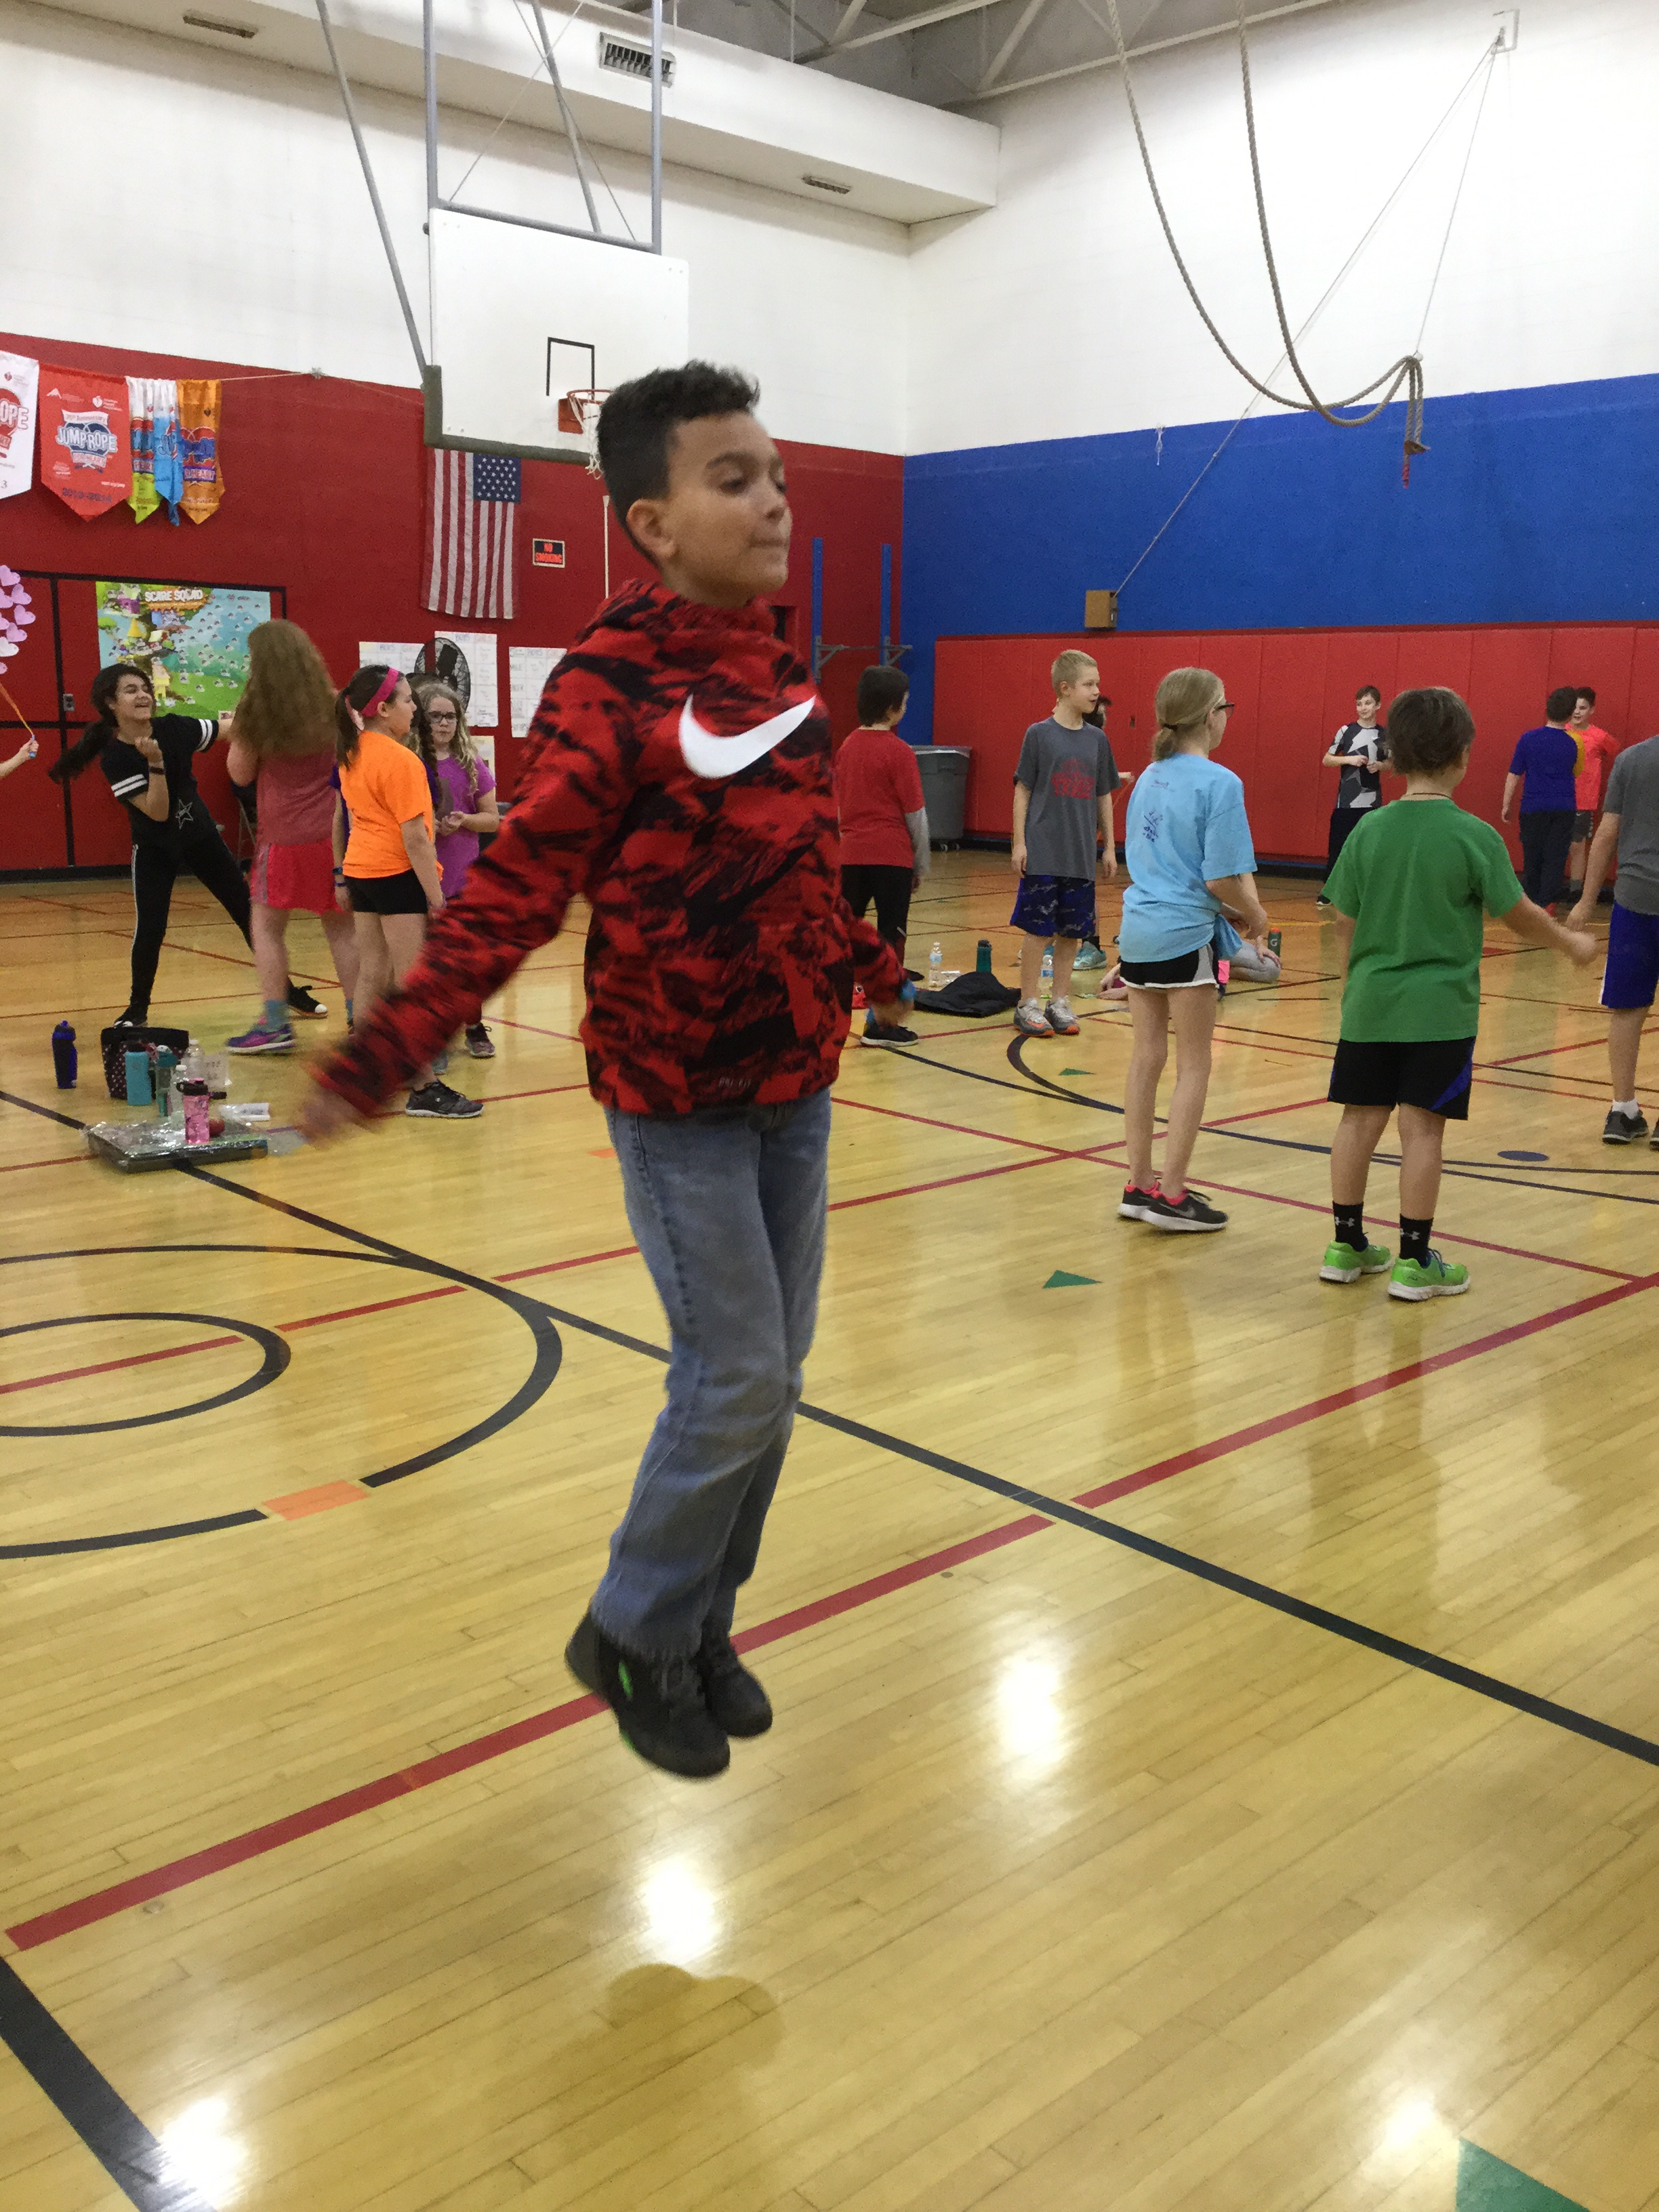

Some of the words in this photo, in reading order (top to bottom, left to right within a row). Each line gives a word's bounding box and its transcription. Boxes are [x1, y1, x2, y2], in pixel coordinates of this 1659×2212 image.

[0, 400, 29, 430] OPE
[56, 427, 87, 448] JUMP
[87, 432, 117, 452] ROPE
[544, 543, 552, 552] NO
[536, 552, 562, 564] SMOKING
[1271, 939, 1278, 947] G
